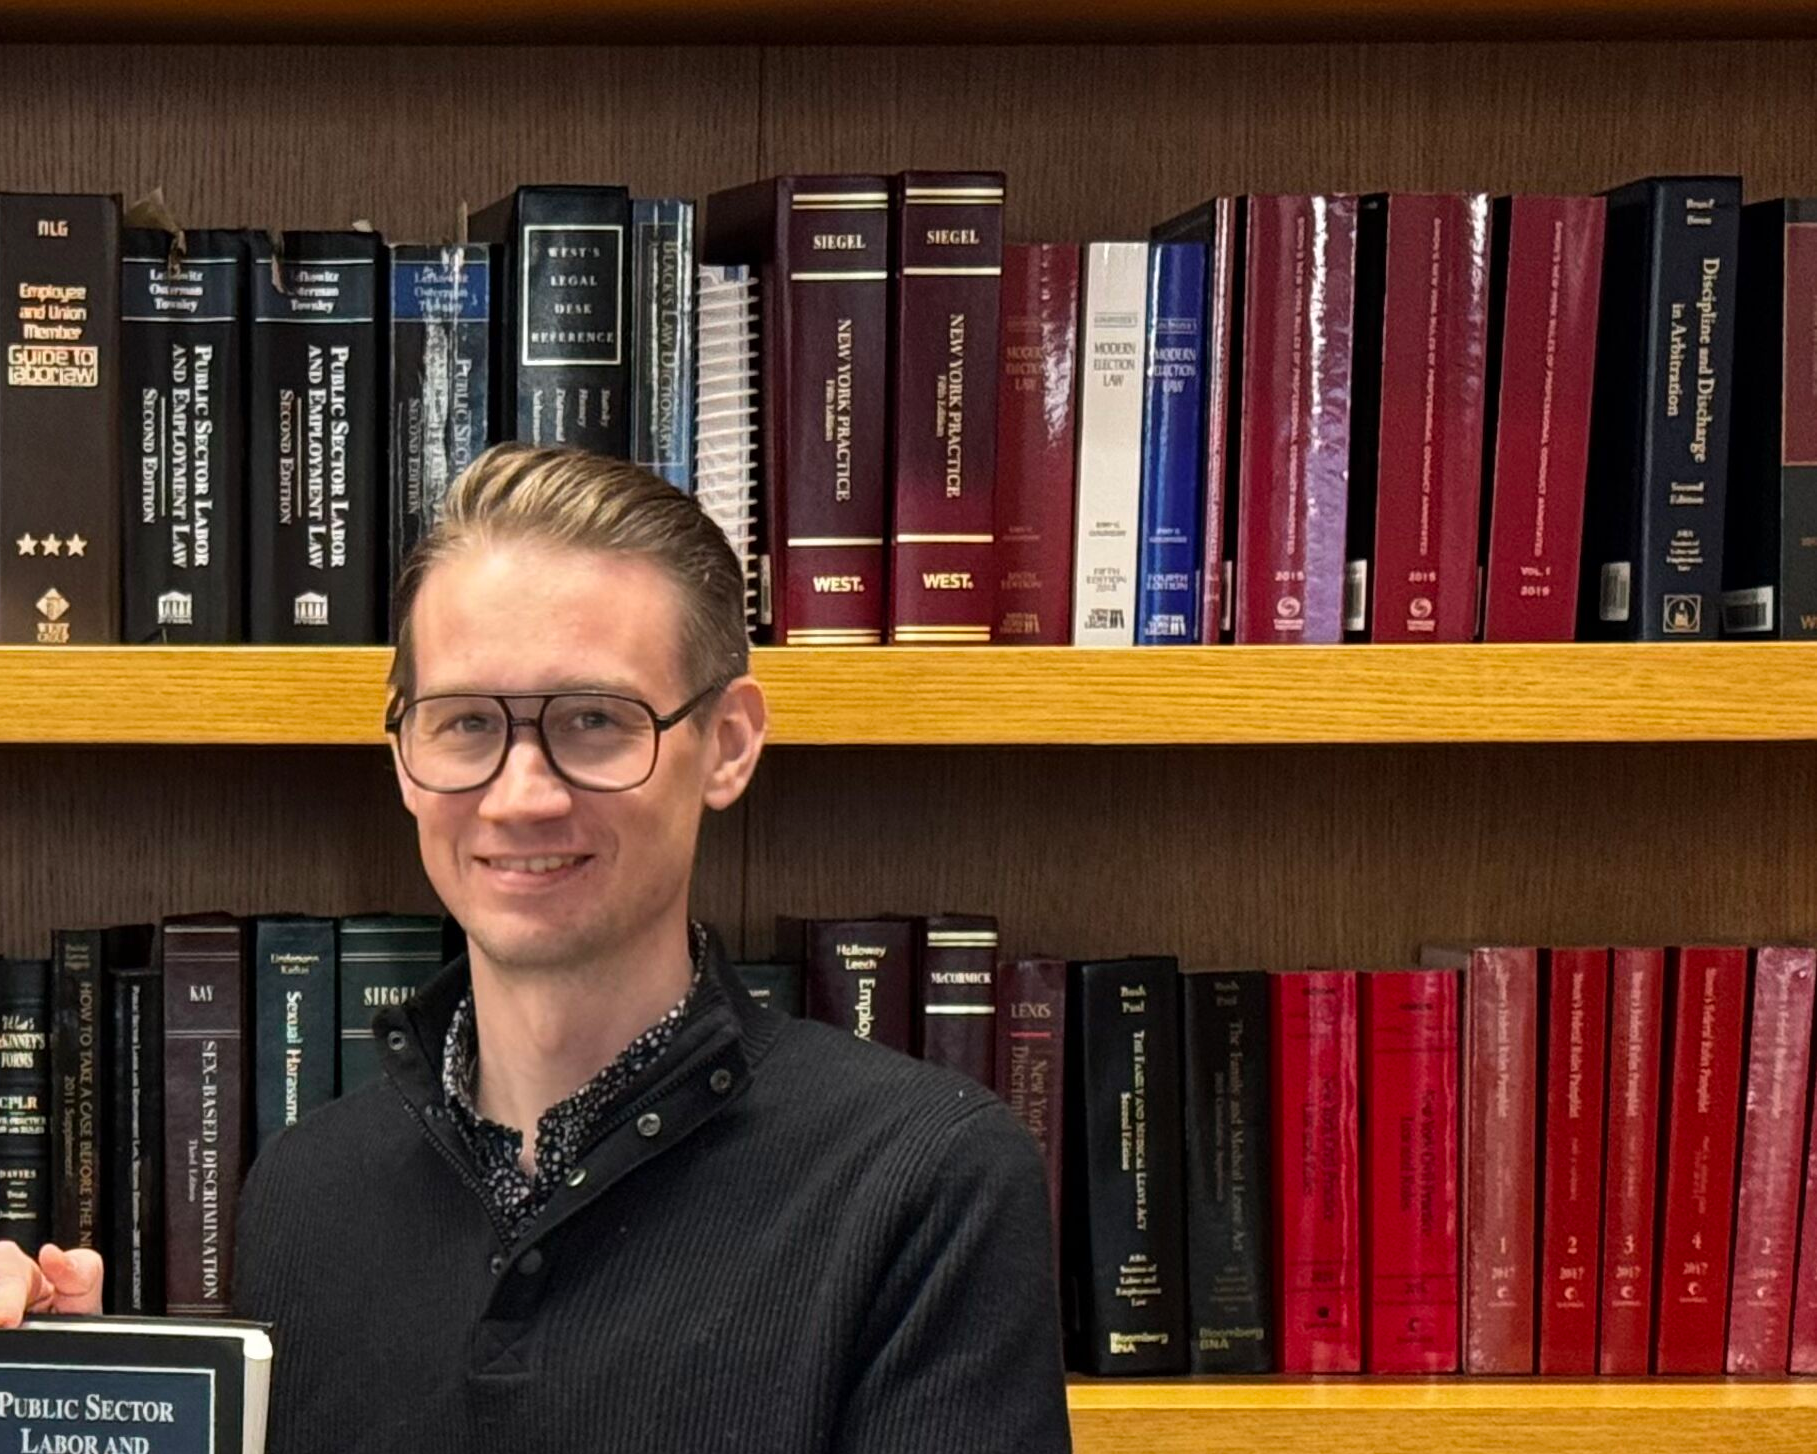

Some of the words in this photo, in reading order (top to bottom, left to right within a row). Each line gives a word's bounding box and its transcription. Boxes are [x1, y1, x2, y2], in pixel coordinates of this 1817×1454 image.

[813, 234, 866, 250] SIEGEL
[926, 229, 980, 245] SIEGEL
[19, 283, 87, 304] Employee
[550, 274, 598, 288] LEGAL
[1696, 257, 1720, 344] Discipline
[19, 305, 45, 320] and
[48, 305, 87, 320] Union
[24, 323, 82, 340] Member
[554, 303, 592, 315] DESK
[950, 313, 965, 350] NEW
[1672, 304, 1685, 319] in
[172, 344, 187, 383] AND
[531, 330, 615, 344] REFERENCE
[837, 318, 852, 356] NEW
[1698, 348, 1713, 374] and
[194, 345, 213, 416] PUBLIC
[308, 344, 323, 384] AND
[330, 345, 349, 417] PUBLIC
[837, 357, 852, 411] YORK
[948, 351, 964, 406] YORK
[1667, 321, 1688, 417] Arbitration
[142, 387, 158, 453] SECOND
[279, 389, 294, 454] SECOND
[1690, 378, 1715, 463] Discharge
[172, 388, 190, 520] EMPLOYMENT
[194, 420, 213, 495] SECTOR
[308, 388, 327, 521] EMPLOYMENT
[330, 421, 349, 497] SECTOR
[836, 414, 851, 501] PRACTICE
[946, 409, 963, 498] PRACTICE
[142, 457, 158, 524] EDITION
[279, 457, 294, 525] EDITION
[172, 524, 190, 568] LAW
[194, 500, 213, 567] LABOR
[308, 525, 327, 569] LAW
[330, 500, 349, 568] LABOR
[845, 959, 877, 970] Leech
[931, 972, 991, 984] McCORMICK
[190, 985, 214, 1001] KAY
[287, 991, 303, 1044] Sexual
[1011, 1003, 1051, 1018] LEXIS
[202, 1040, 217, 1143] SEX-BASED
[203, 1150, 219, 1299] DISCRIMINATION
[85, 1394, 174, 1423] SECTOR
